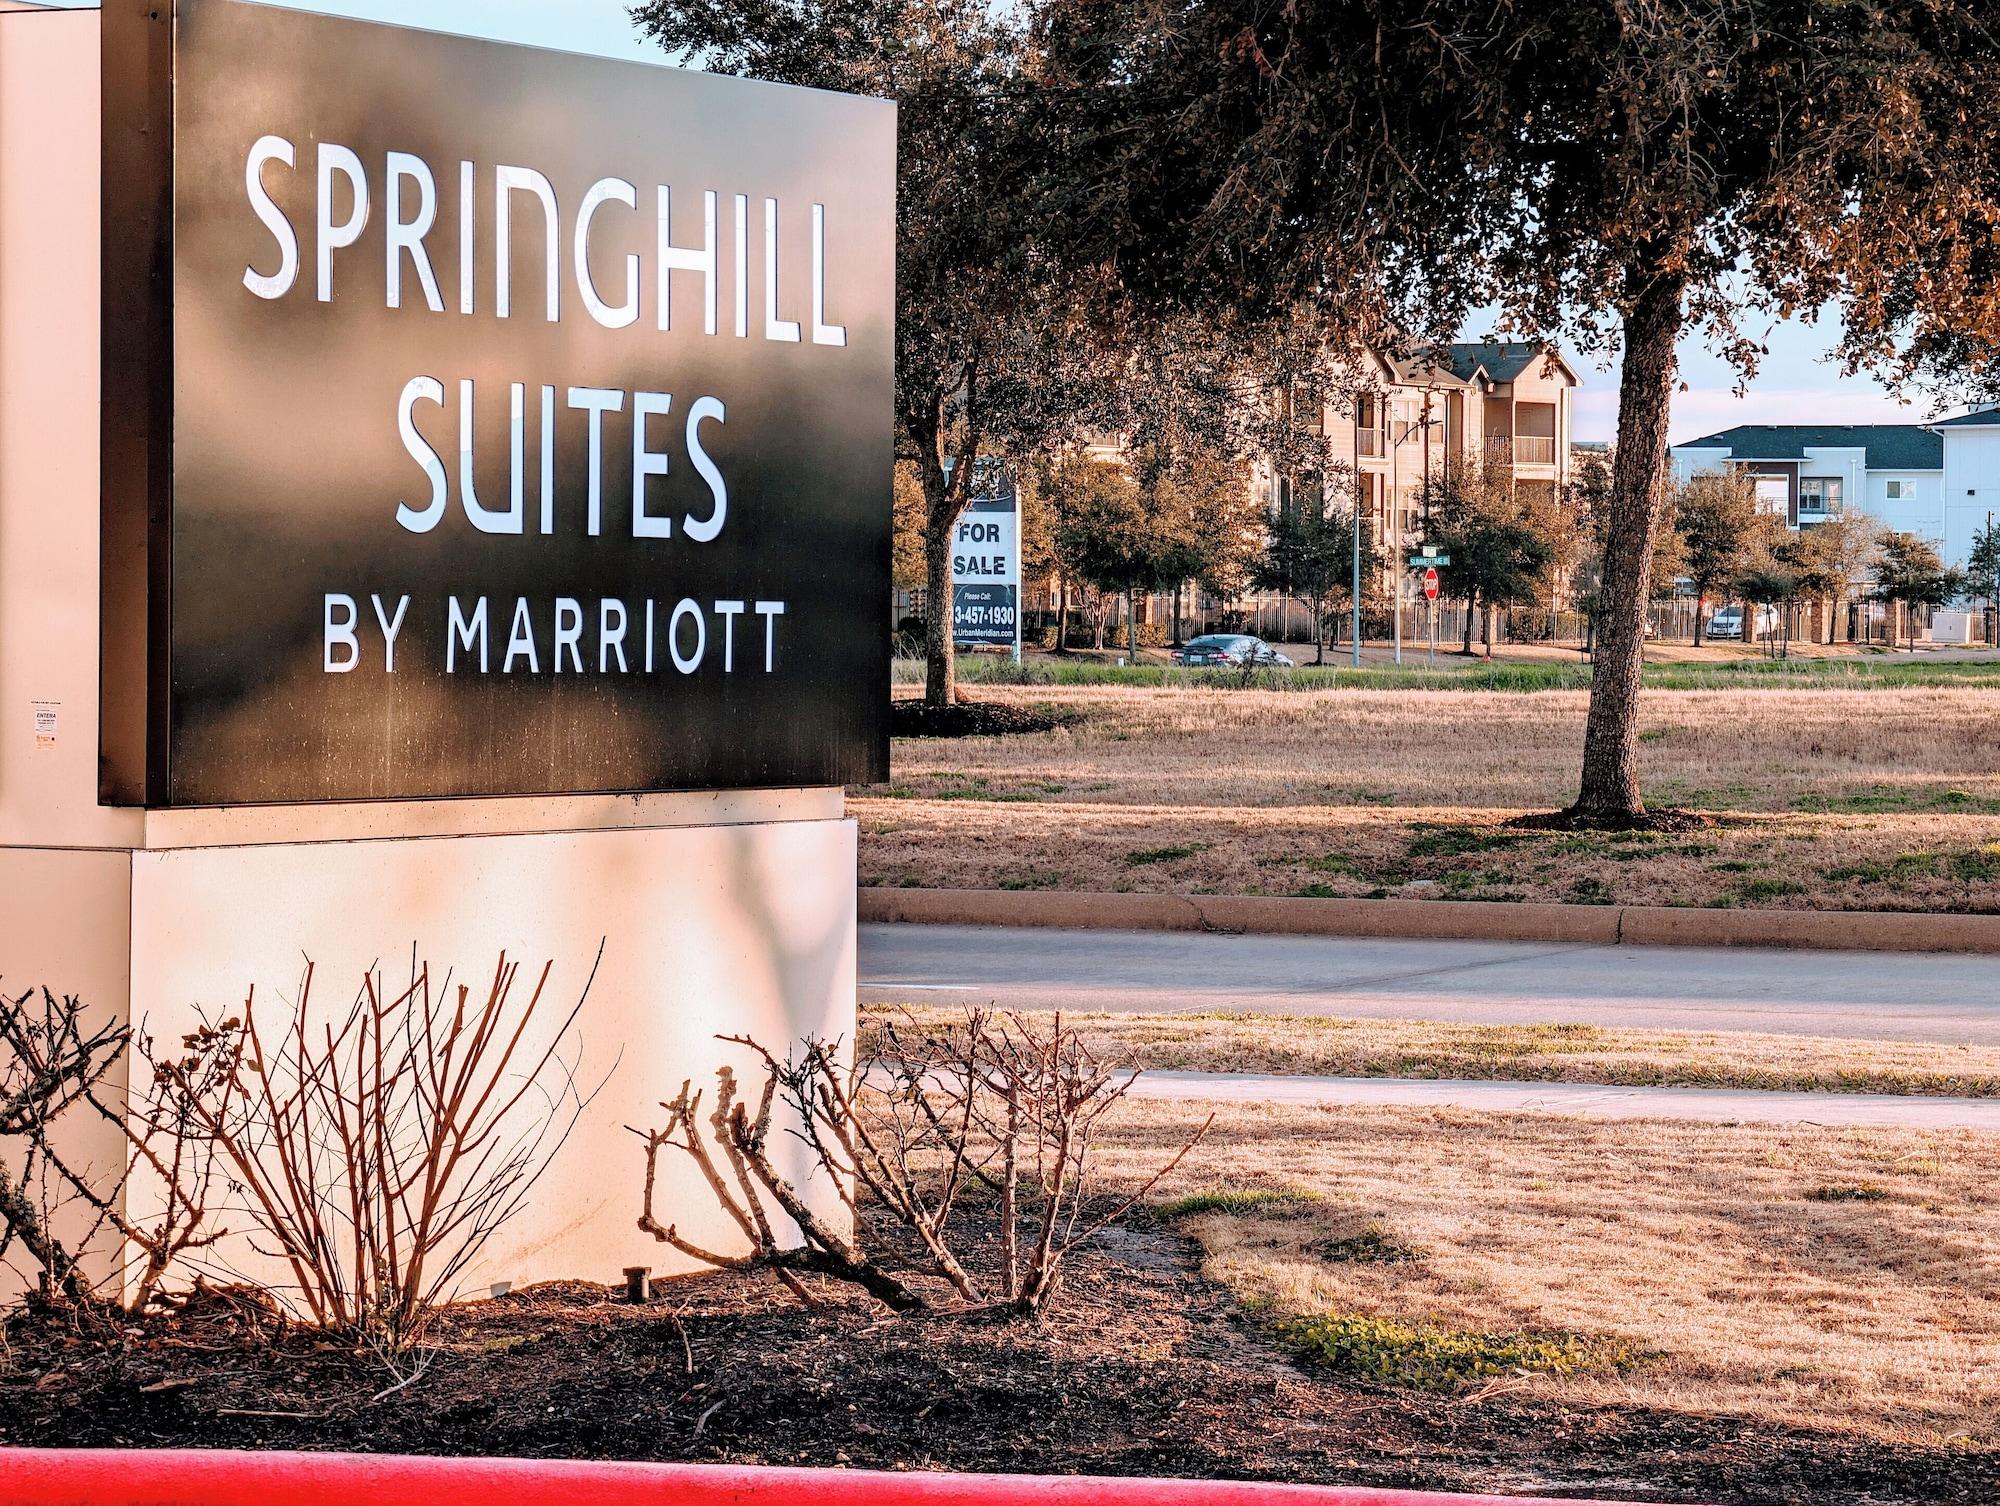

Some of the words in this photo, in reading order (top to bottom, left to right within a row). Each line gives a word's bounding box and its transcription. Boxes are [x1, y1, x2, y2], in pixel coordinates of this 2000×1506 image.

[242, 135, 847, 347] SPRINGHILL
[395, 375, 728, 542] SUITES
[959, 523, 1000, 542] FOR
[953, 556, 1005, 575] SALE
[1425, 579, 1437, 591] STOP
[323, 593, 410, 674] BY
[446, 595, 785, 674] MARRIOTT
